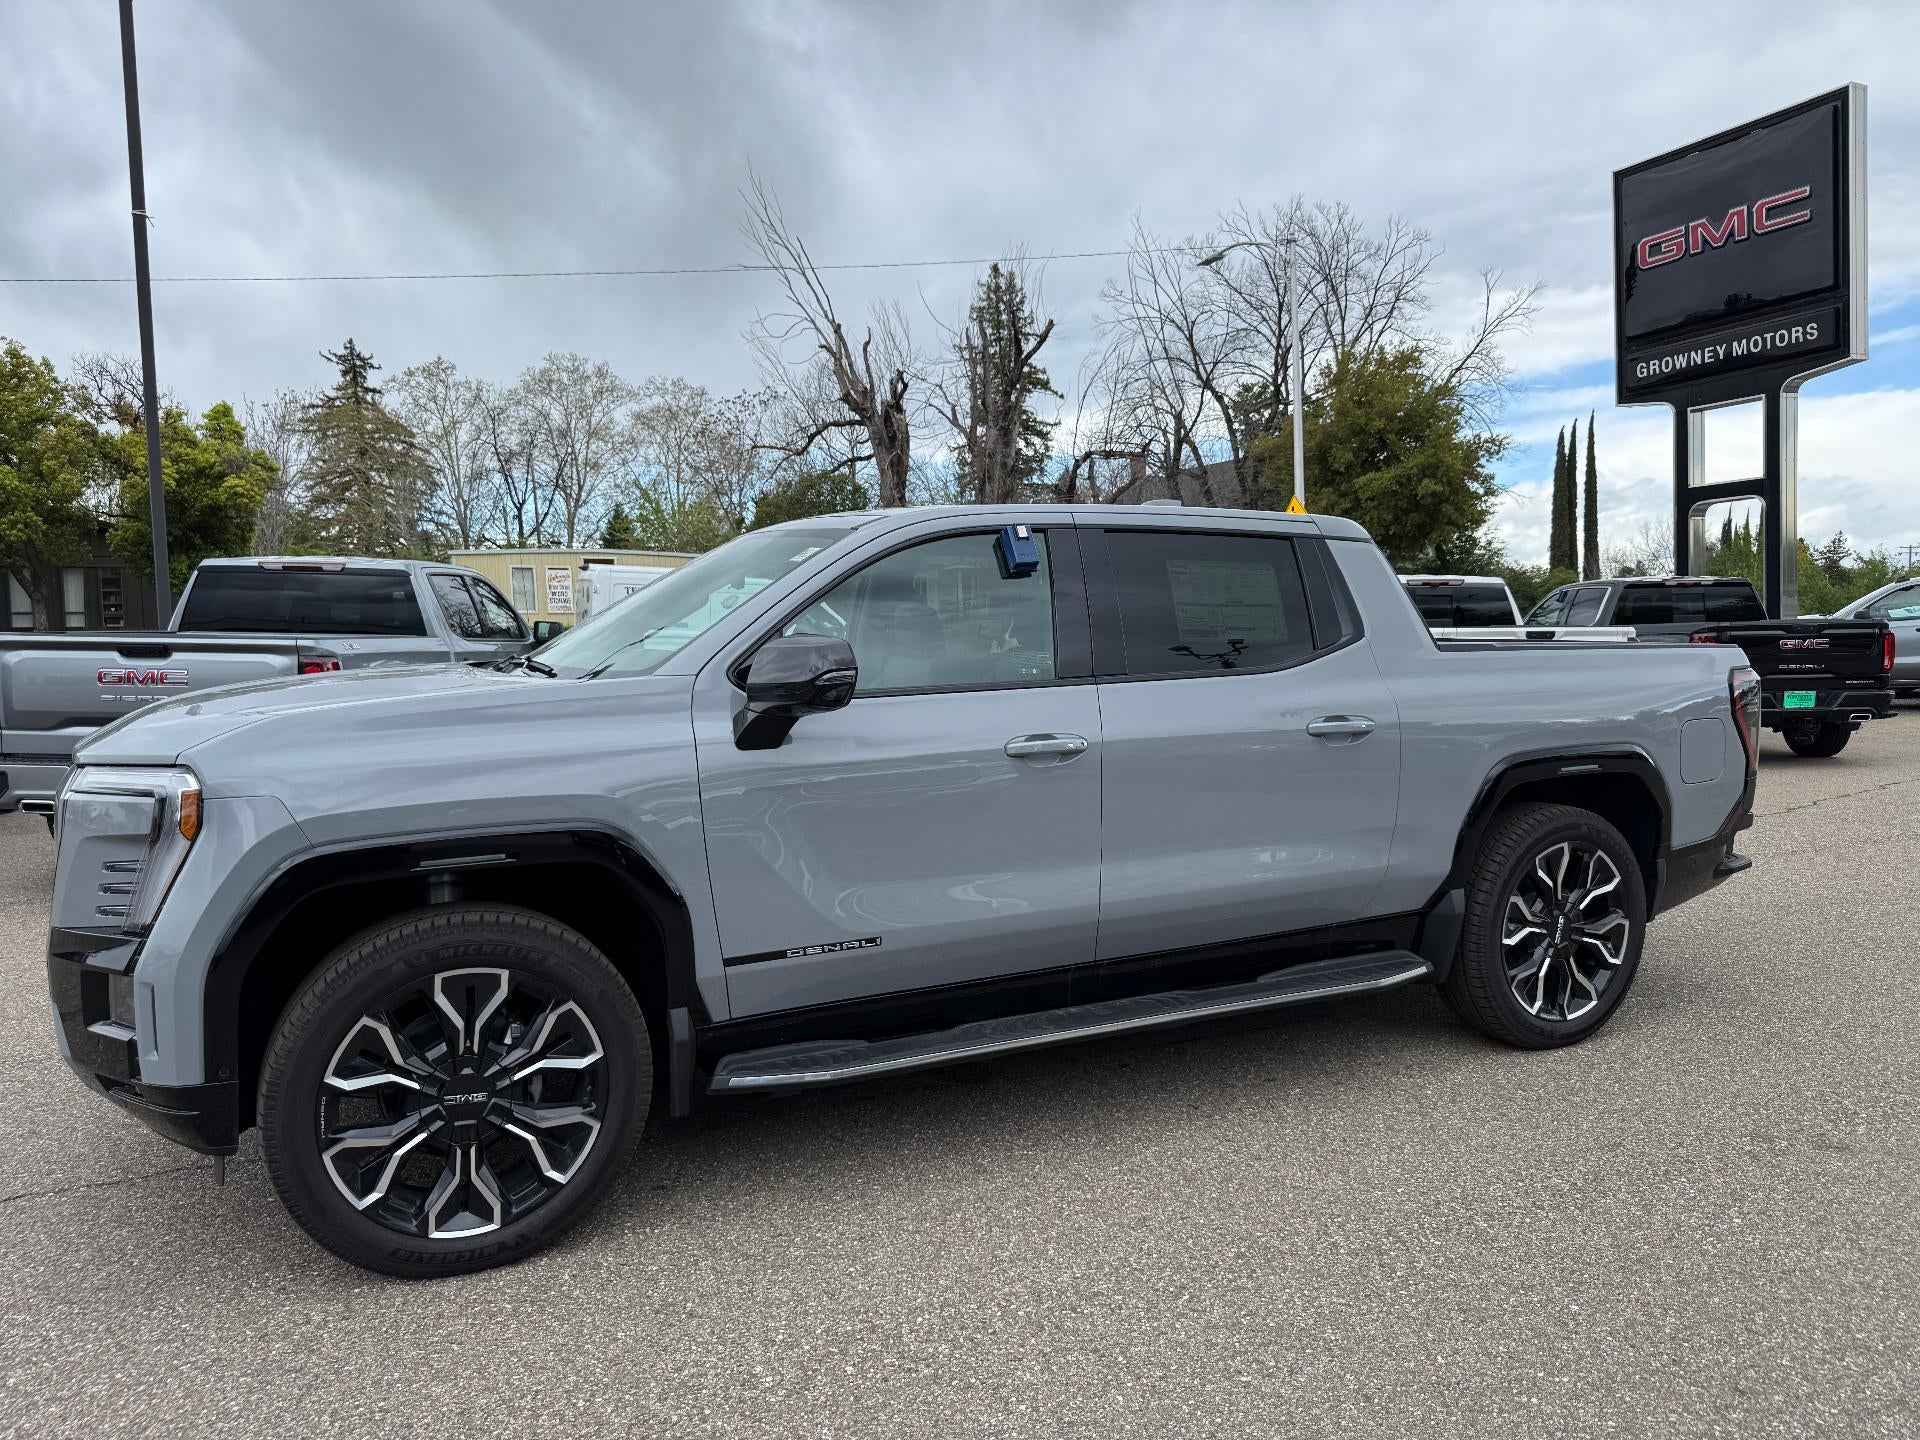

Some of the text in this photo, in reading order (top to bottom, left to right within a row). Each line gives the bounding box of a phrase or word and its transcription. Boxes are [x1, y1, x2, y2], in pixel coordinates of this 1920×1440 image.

[1637, 184, 1812, 269] GMC
[1636, 322, 1819, 378] GROWNEY MOTORS
[1779, 638, 1830, 649] GMC
[97, 668, 189, 687] GMC
[100, 694, 169, 702] SIER
[786, 937, 881, 958] DENALI
[442, 1092, 488, 1107] GMC
